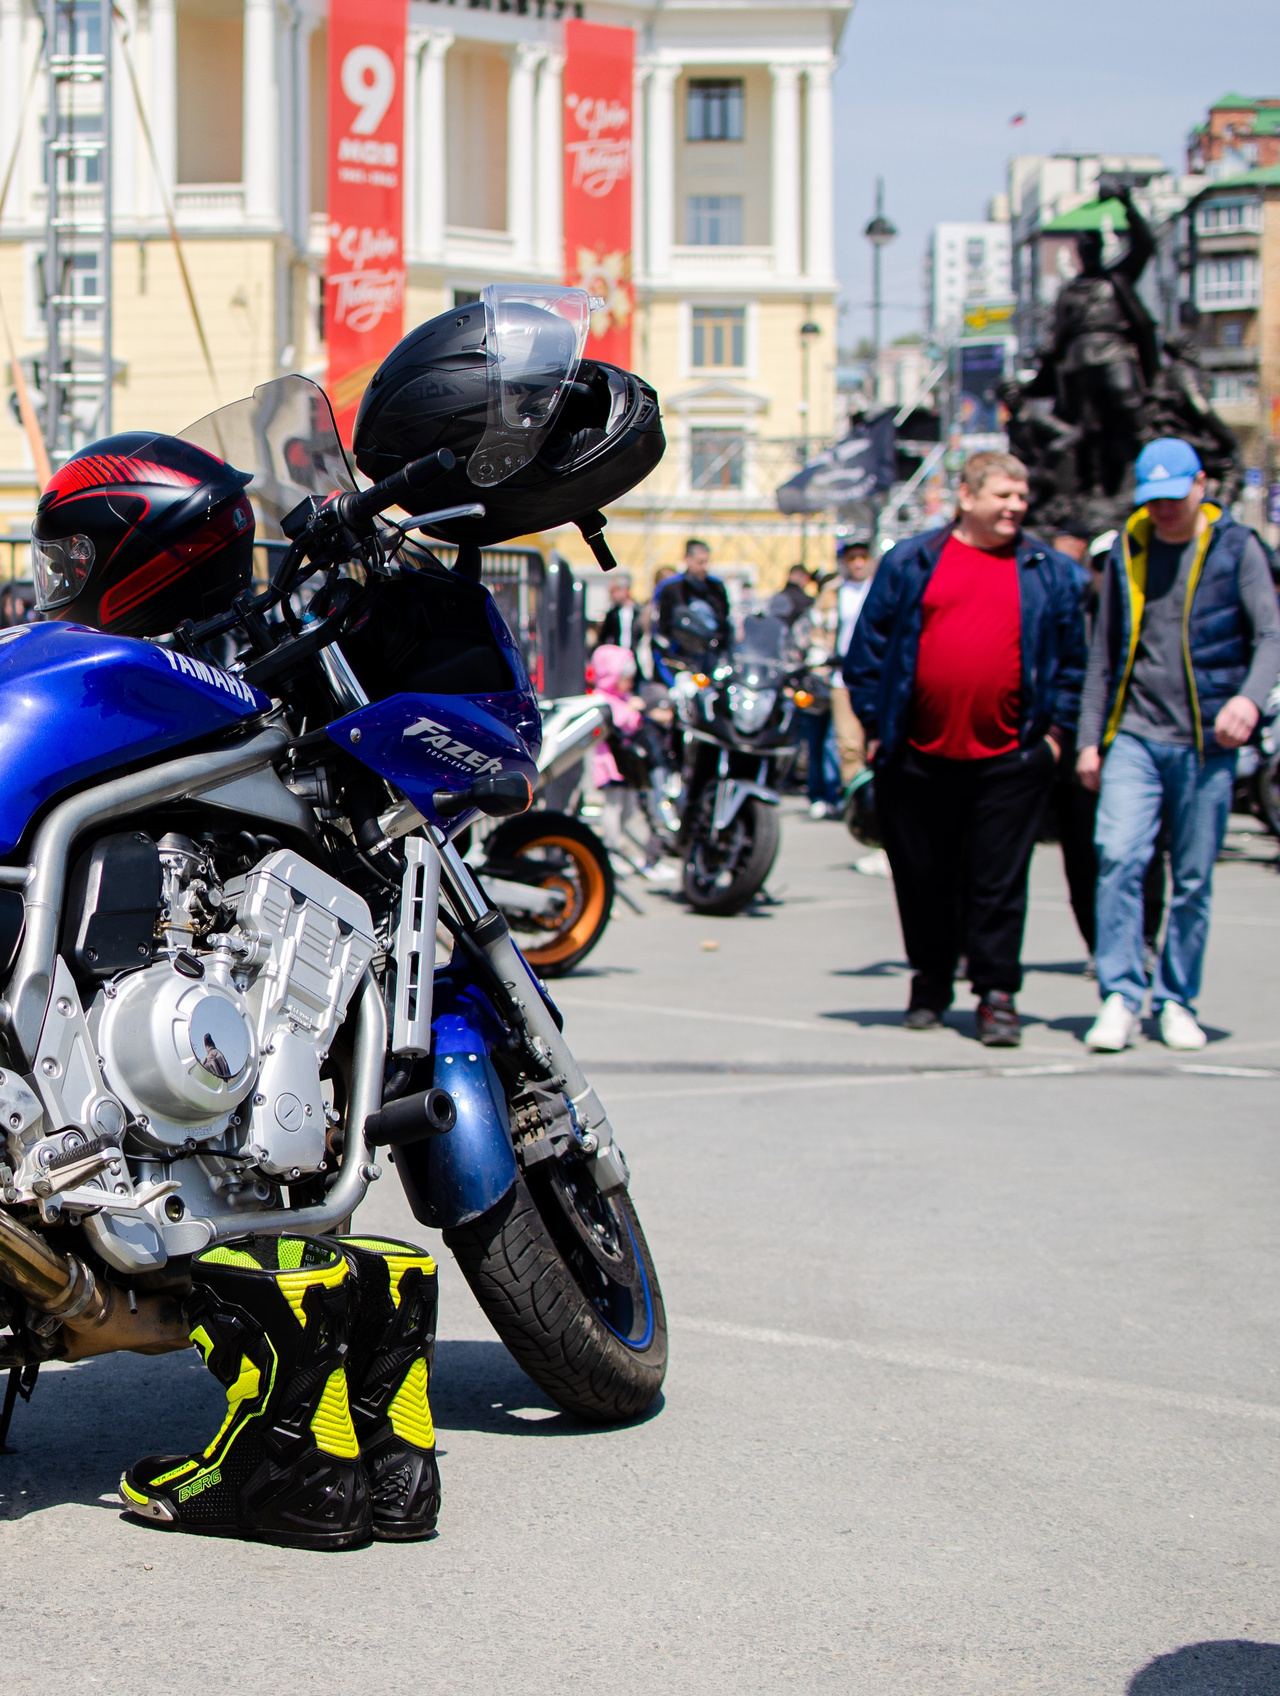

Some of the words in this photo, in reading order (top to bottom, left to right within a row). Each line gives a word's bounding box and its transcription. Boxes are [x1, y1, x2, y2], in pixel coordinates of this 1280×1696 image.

[341, 45, 396, 135] 9
[156, 645, 256, 708] YAMAHA
[403, 717, 503, 774] FAZER
[426, 748, 472, 773] 1000-EXUP
[156, 1462, 191, 1485] TRACKER
[178, 1468, 223, 1503] BERG
